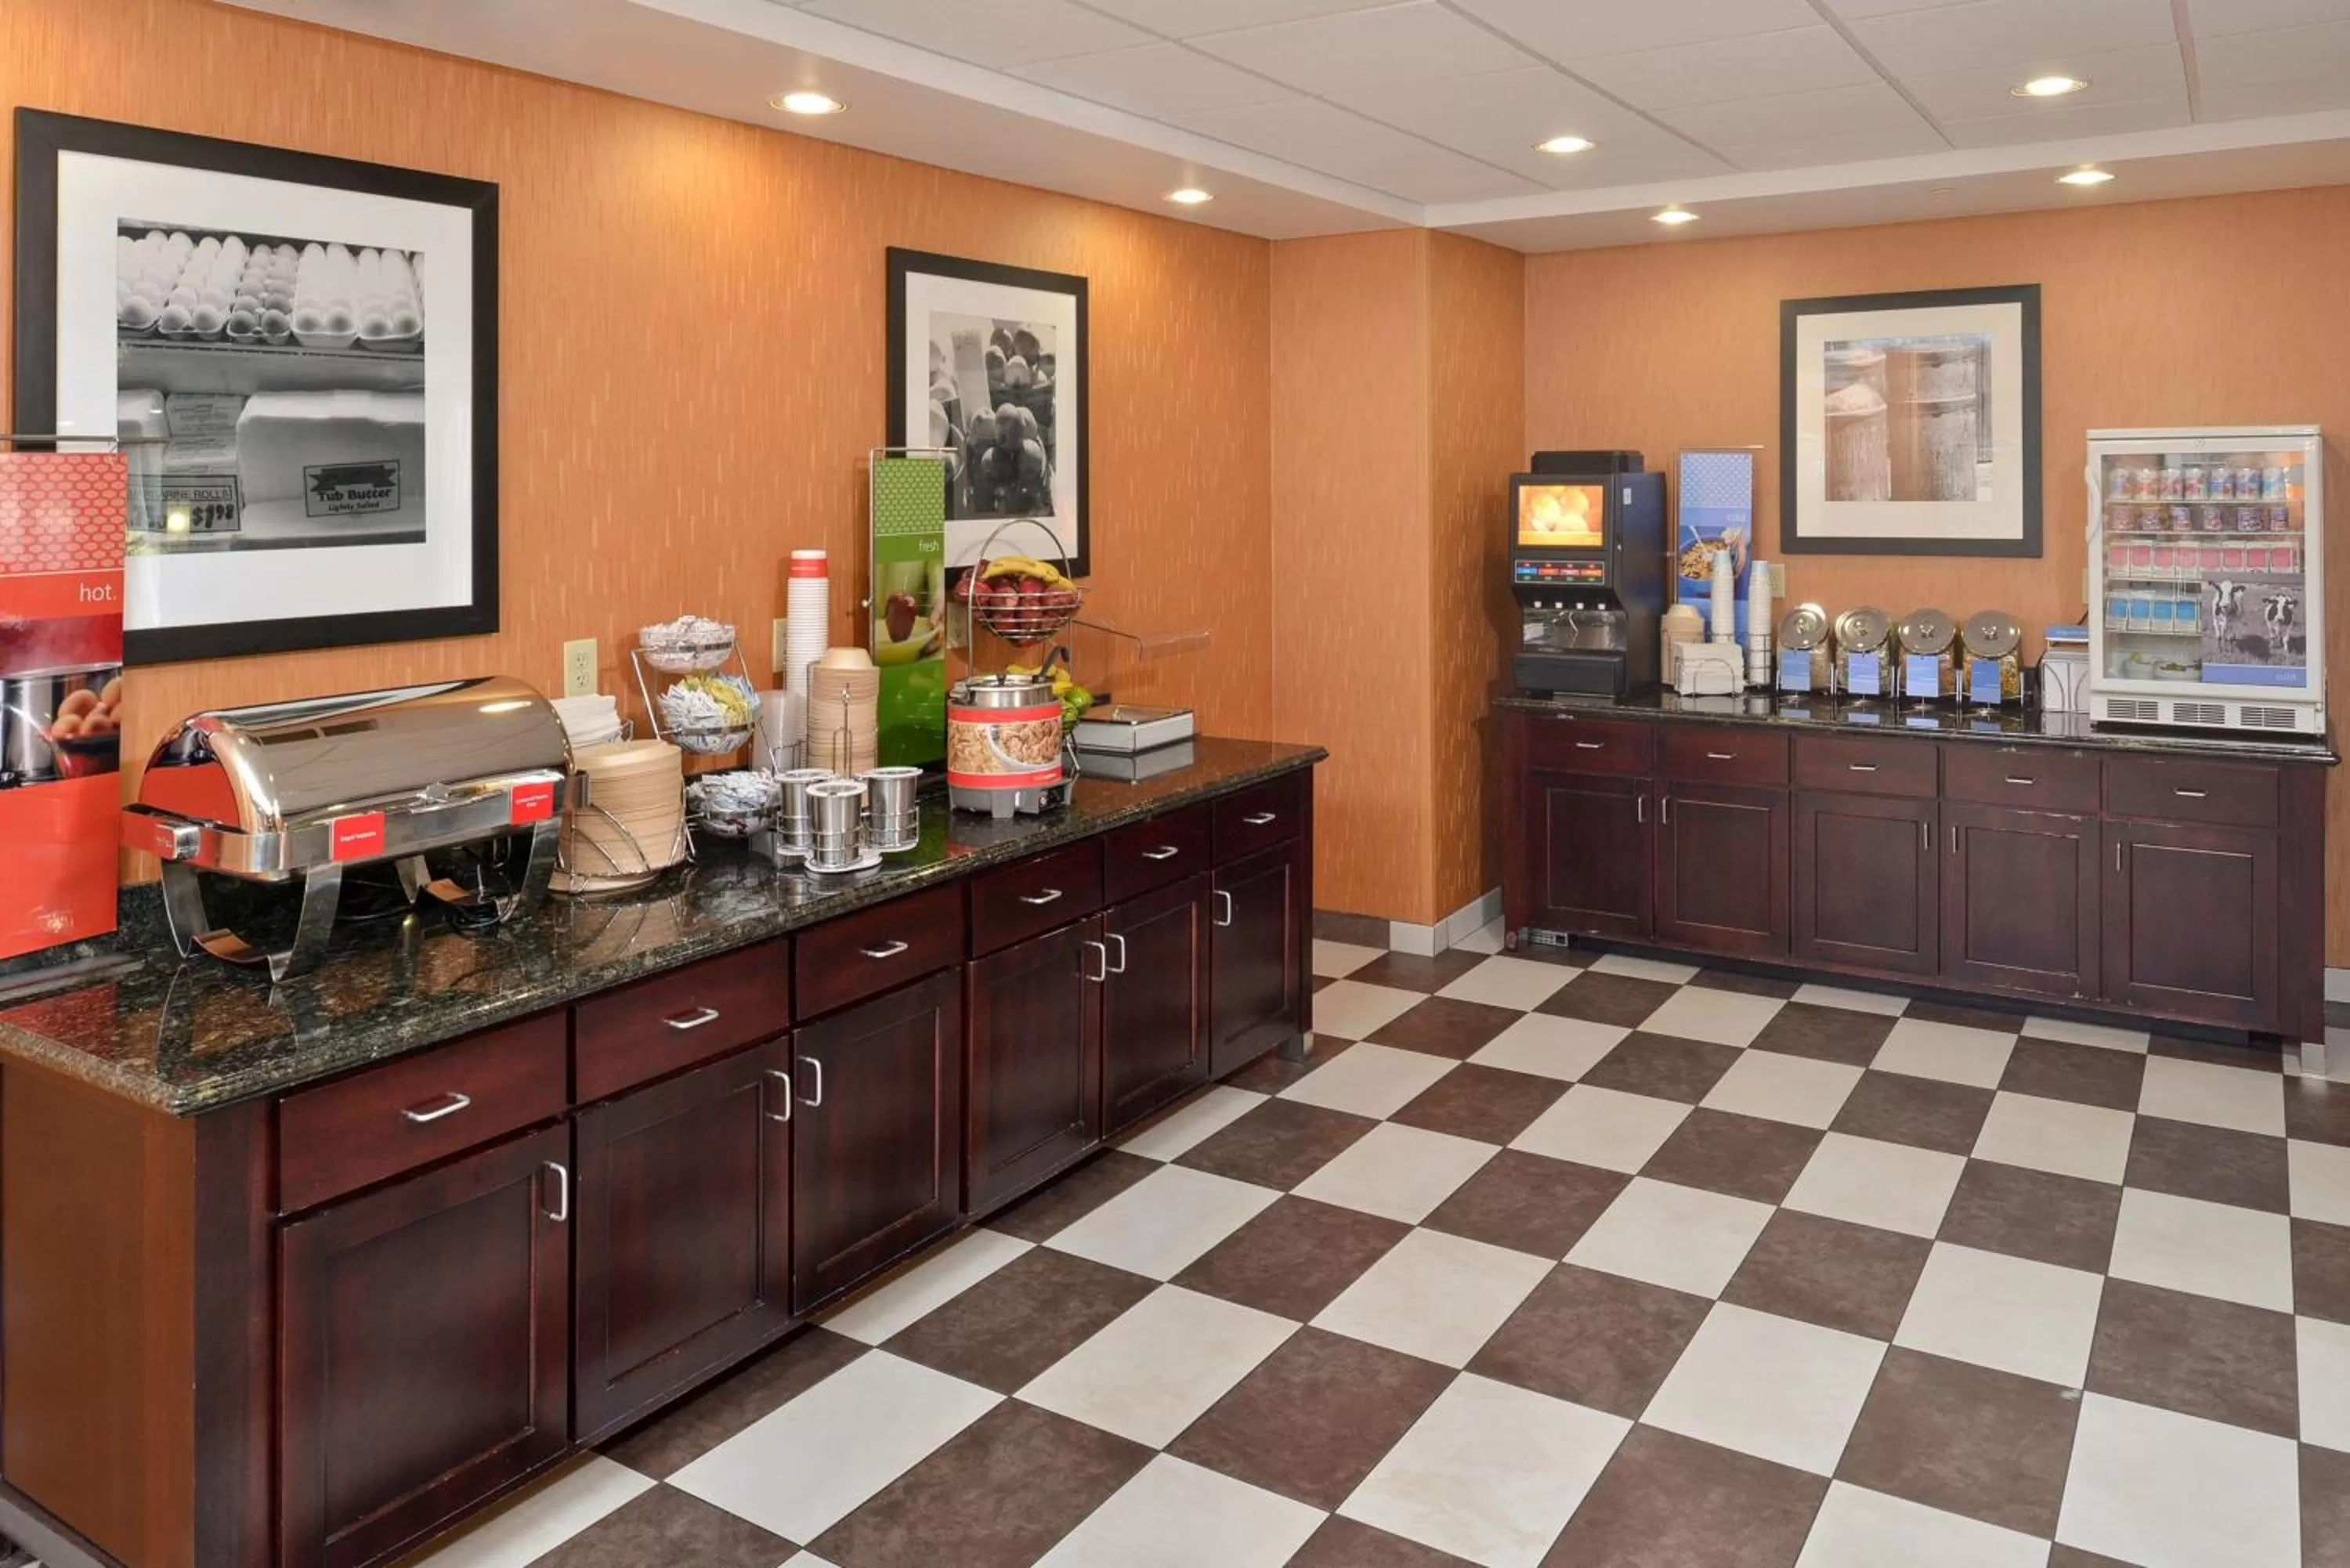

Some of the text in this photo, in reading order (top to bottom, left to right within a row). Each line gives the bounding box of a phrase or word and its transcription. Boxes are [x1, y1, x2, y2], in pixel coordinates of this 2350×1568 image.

[317, 489, 391, 502] Tub Butter
[80, 582, 117, 602] hot.
